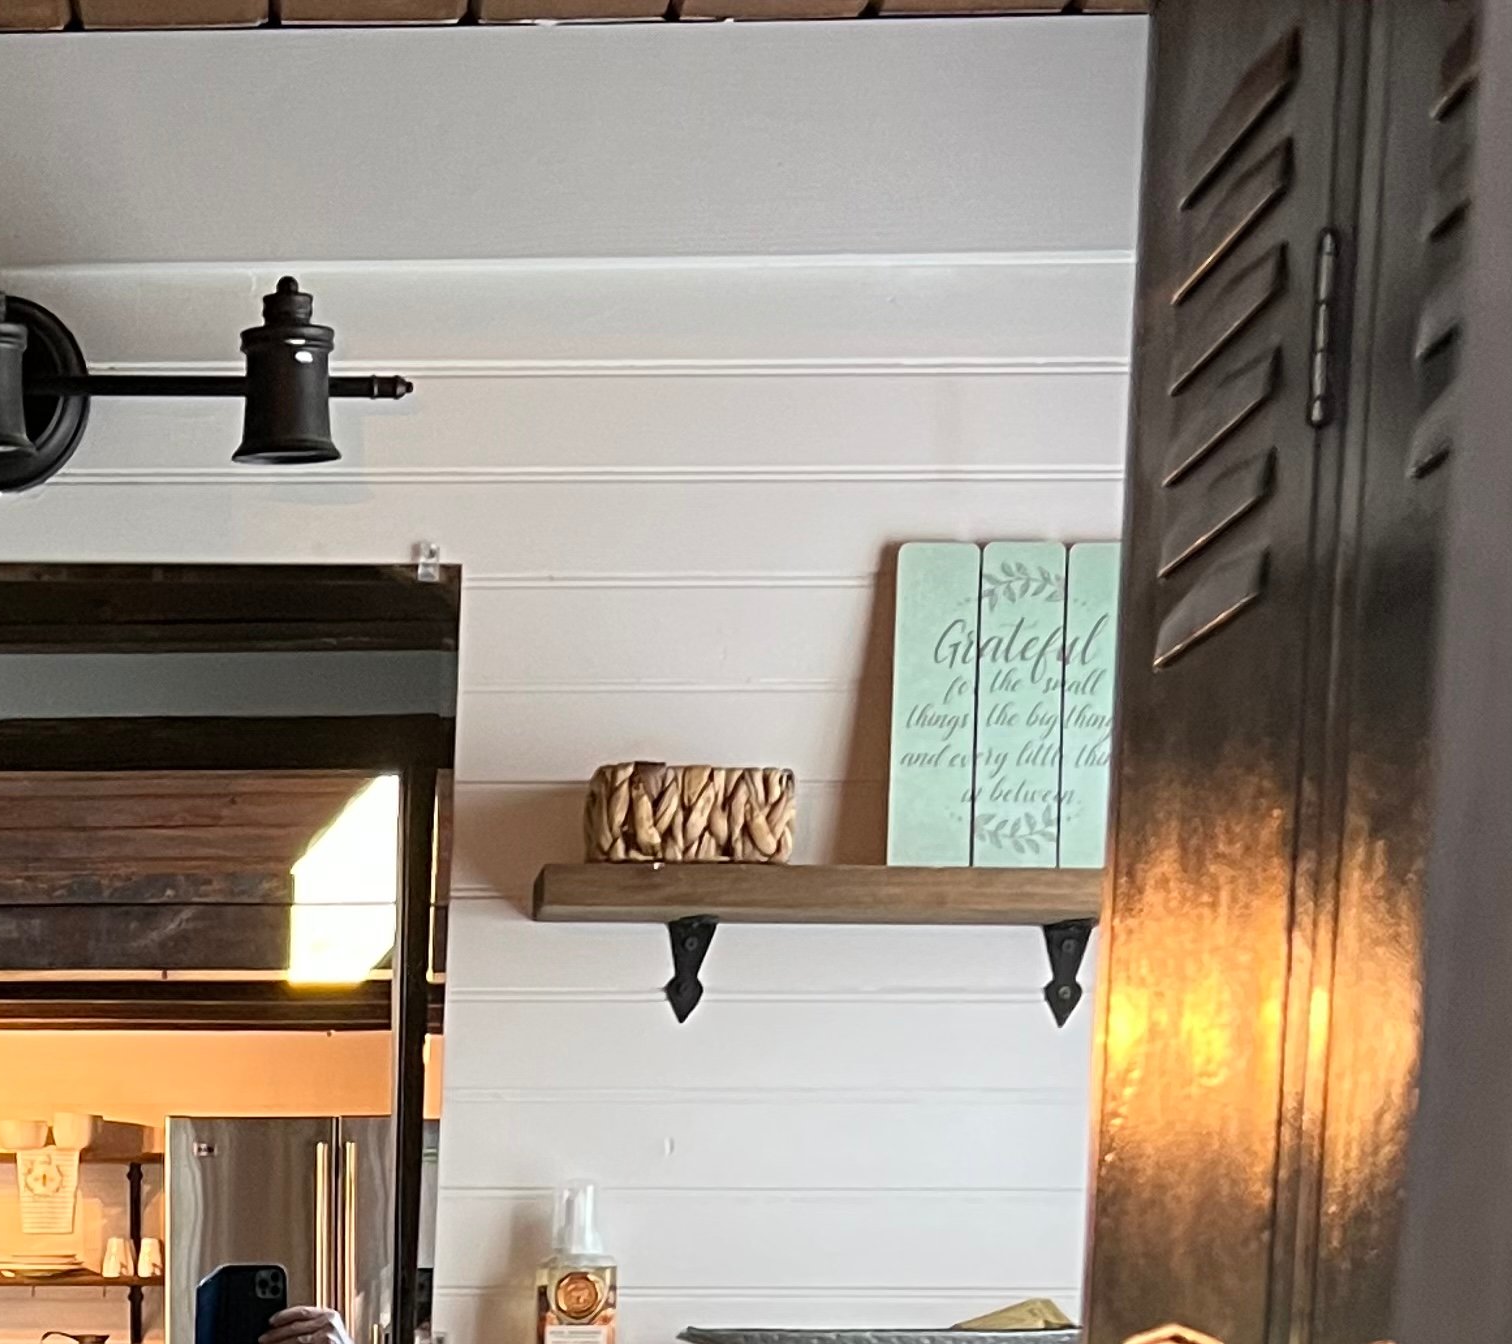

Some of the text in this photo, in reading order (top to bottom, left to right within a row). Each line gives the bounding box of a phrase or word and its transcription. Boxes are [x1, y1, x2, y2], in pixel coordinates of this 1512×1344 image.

[934, 613, 1109, 684] Grateful
[943, 675, 971, 704] fo
[990, 667, 1023, 693] the
[986, 701, 1018, 727] the
[1026, 701, 1059, 739] big
[900, 744, 951, 767] and
[948, 748, 1008, 778] evry
